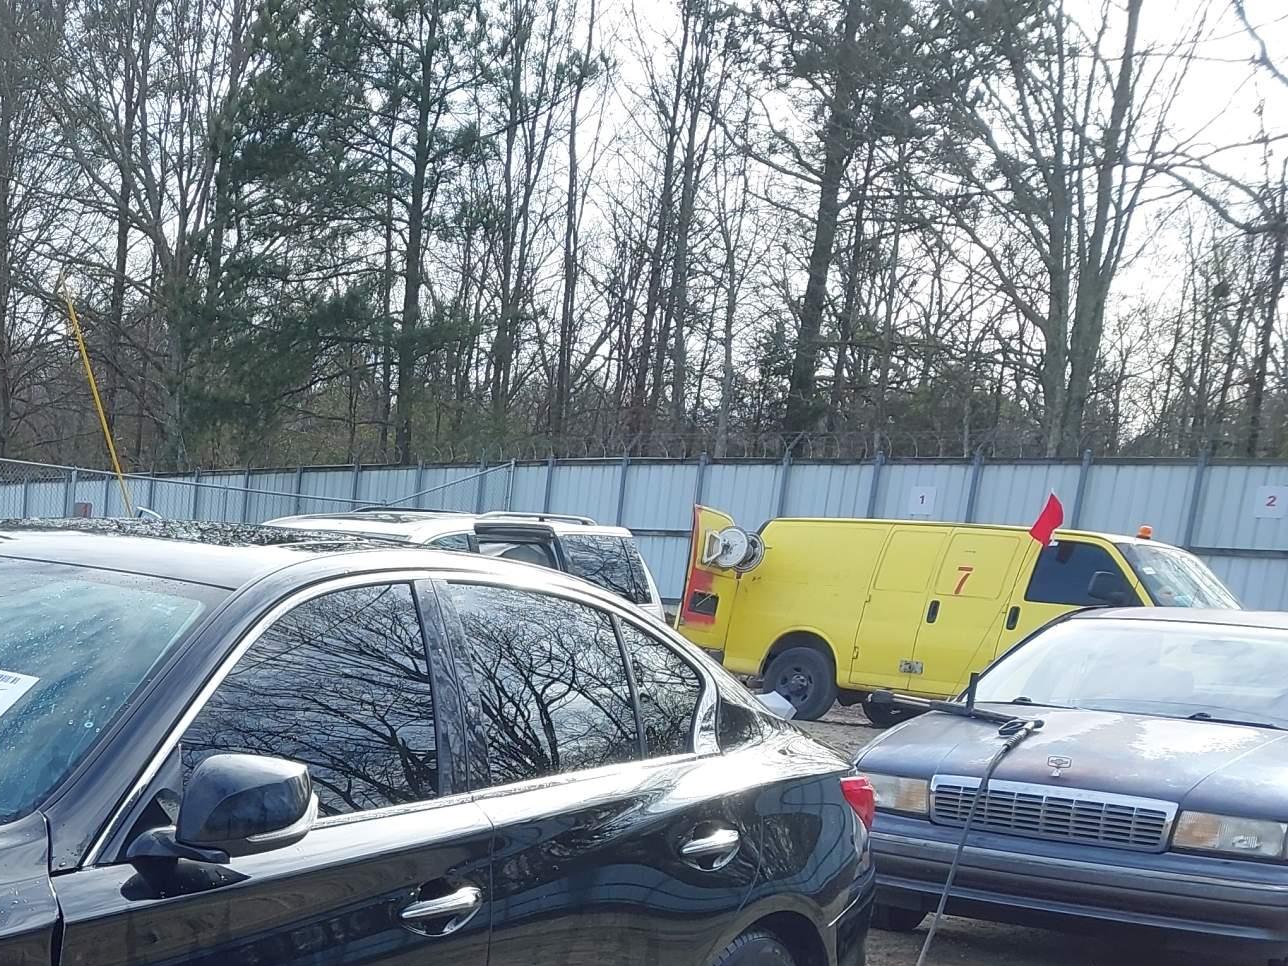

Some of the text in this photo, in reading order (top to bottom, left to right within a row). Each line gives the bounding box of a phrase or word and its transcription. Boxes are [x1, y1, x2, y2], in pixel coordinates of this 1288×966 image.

[919, 495, 926, 505] 1
[1265, 495, 1277, 507] 2
[954, 566, 974, 595] 7
